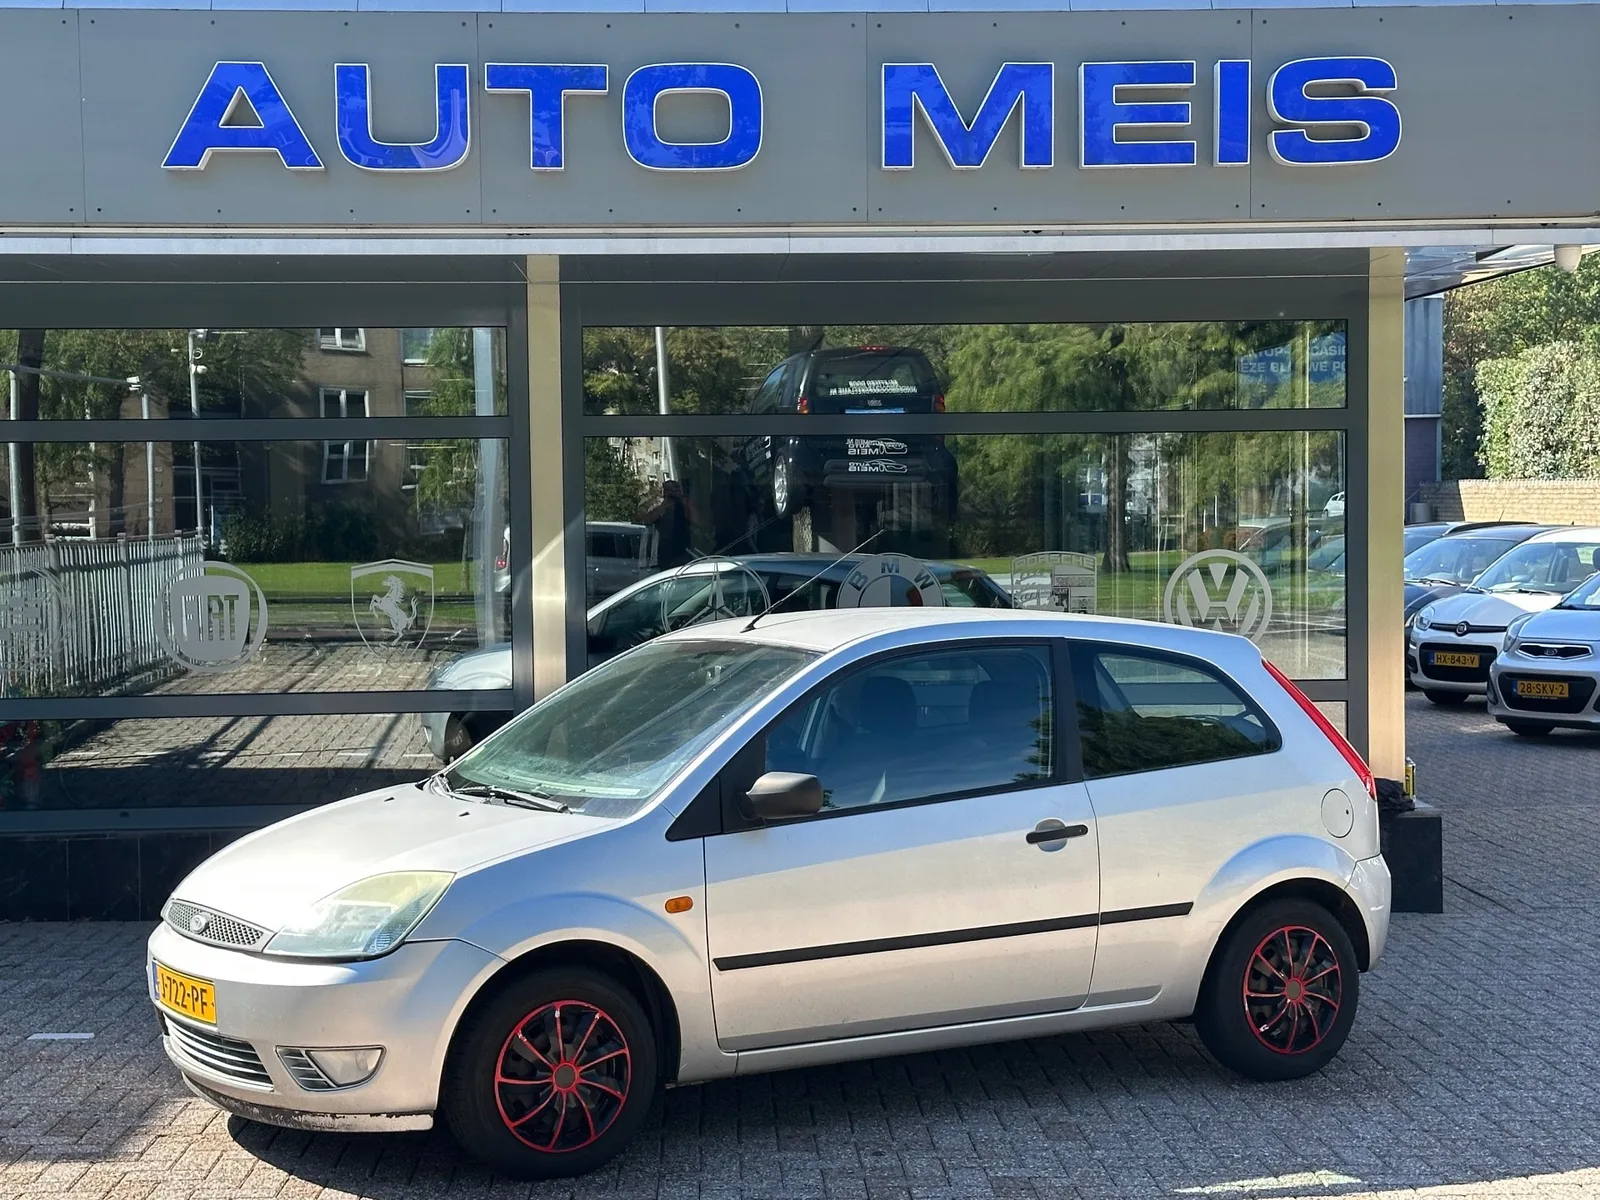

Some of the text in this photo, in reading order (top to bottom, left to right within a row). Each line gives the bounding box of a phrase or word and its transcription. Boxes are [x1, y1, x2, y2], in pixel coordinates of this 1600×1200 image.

[161, 56, 1403, 173] AUTO MEIS
[848, 558, 935, 593] BMW
[1013, 552, 1096, 572] PORSCHE
[181, 594, 240, 641] FIAT
[1435, 654, 1476, 666] HX-843-V
[1520, 682, 1565, 695] 28-SKV-2
